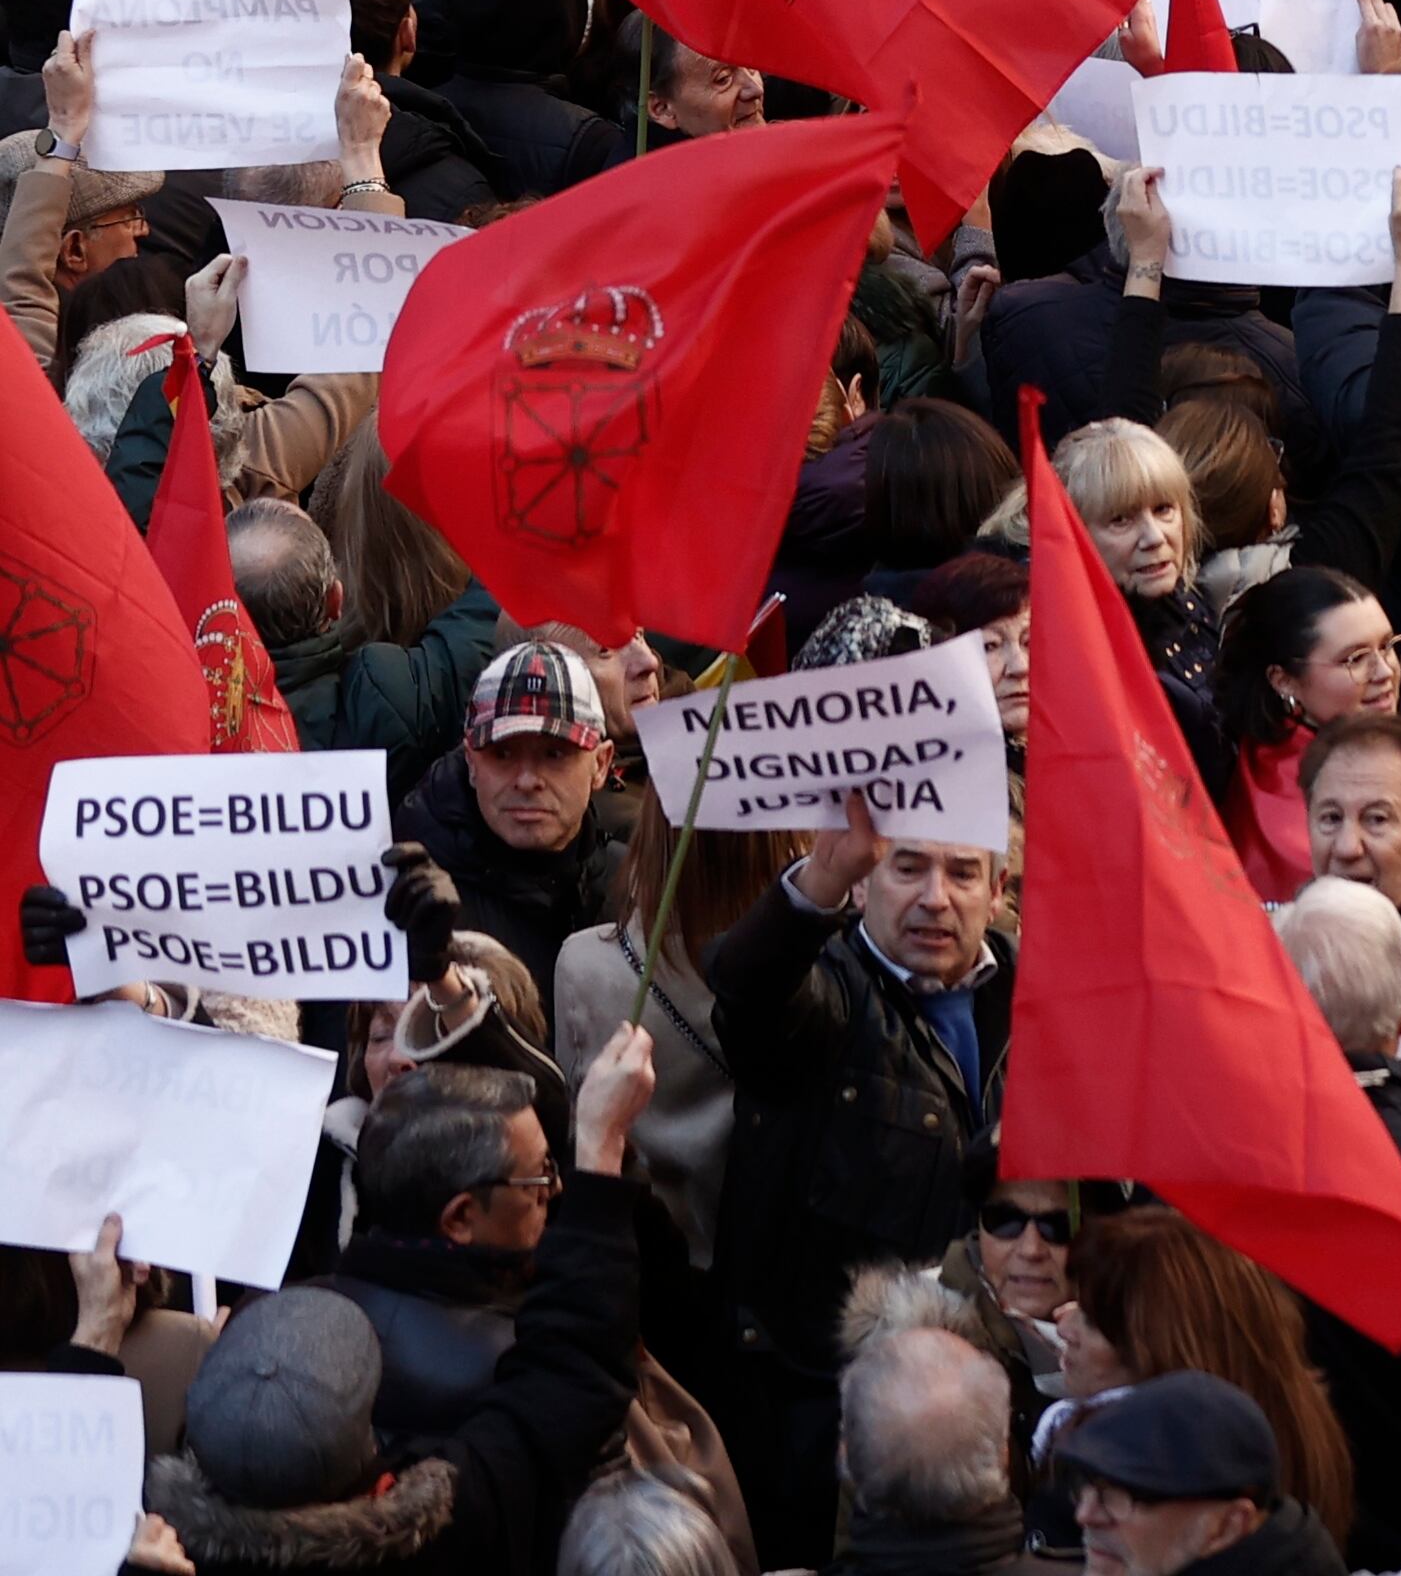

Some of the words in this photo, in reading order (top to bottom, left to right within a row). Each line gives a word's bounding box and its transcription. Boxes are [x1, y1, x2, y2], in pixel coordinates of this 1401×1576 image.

[683, 678, 957, 733] MEMORIA,
[696, 737, 964, 782] DIGNIDAD,
[75, 790, 372, 839] PSOE=BILDU
[737, 777, 943, 817] JUSTCIA
[79, 864, 384, 912] PSOE=BILDU
[102, 925, 393, 976] PSOE=BILDU
